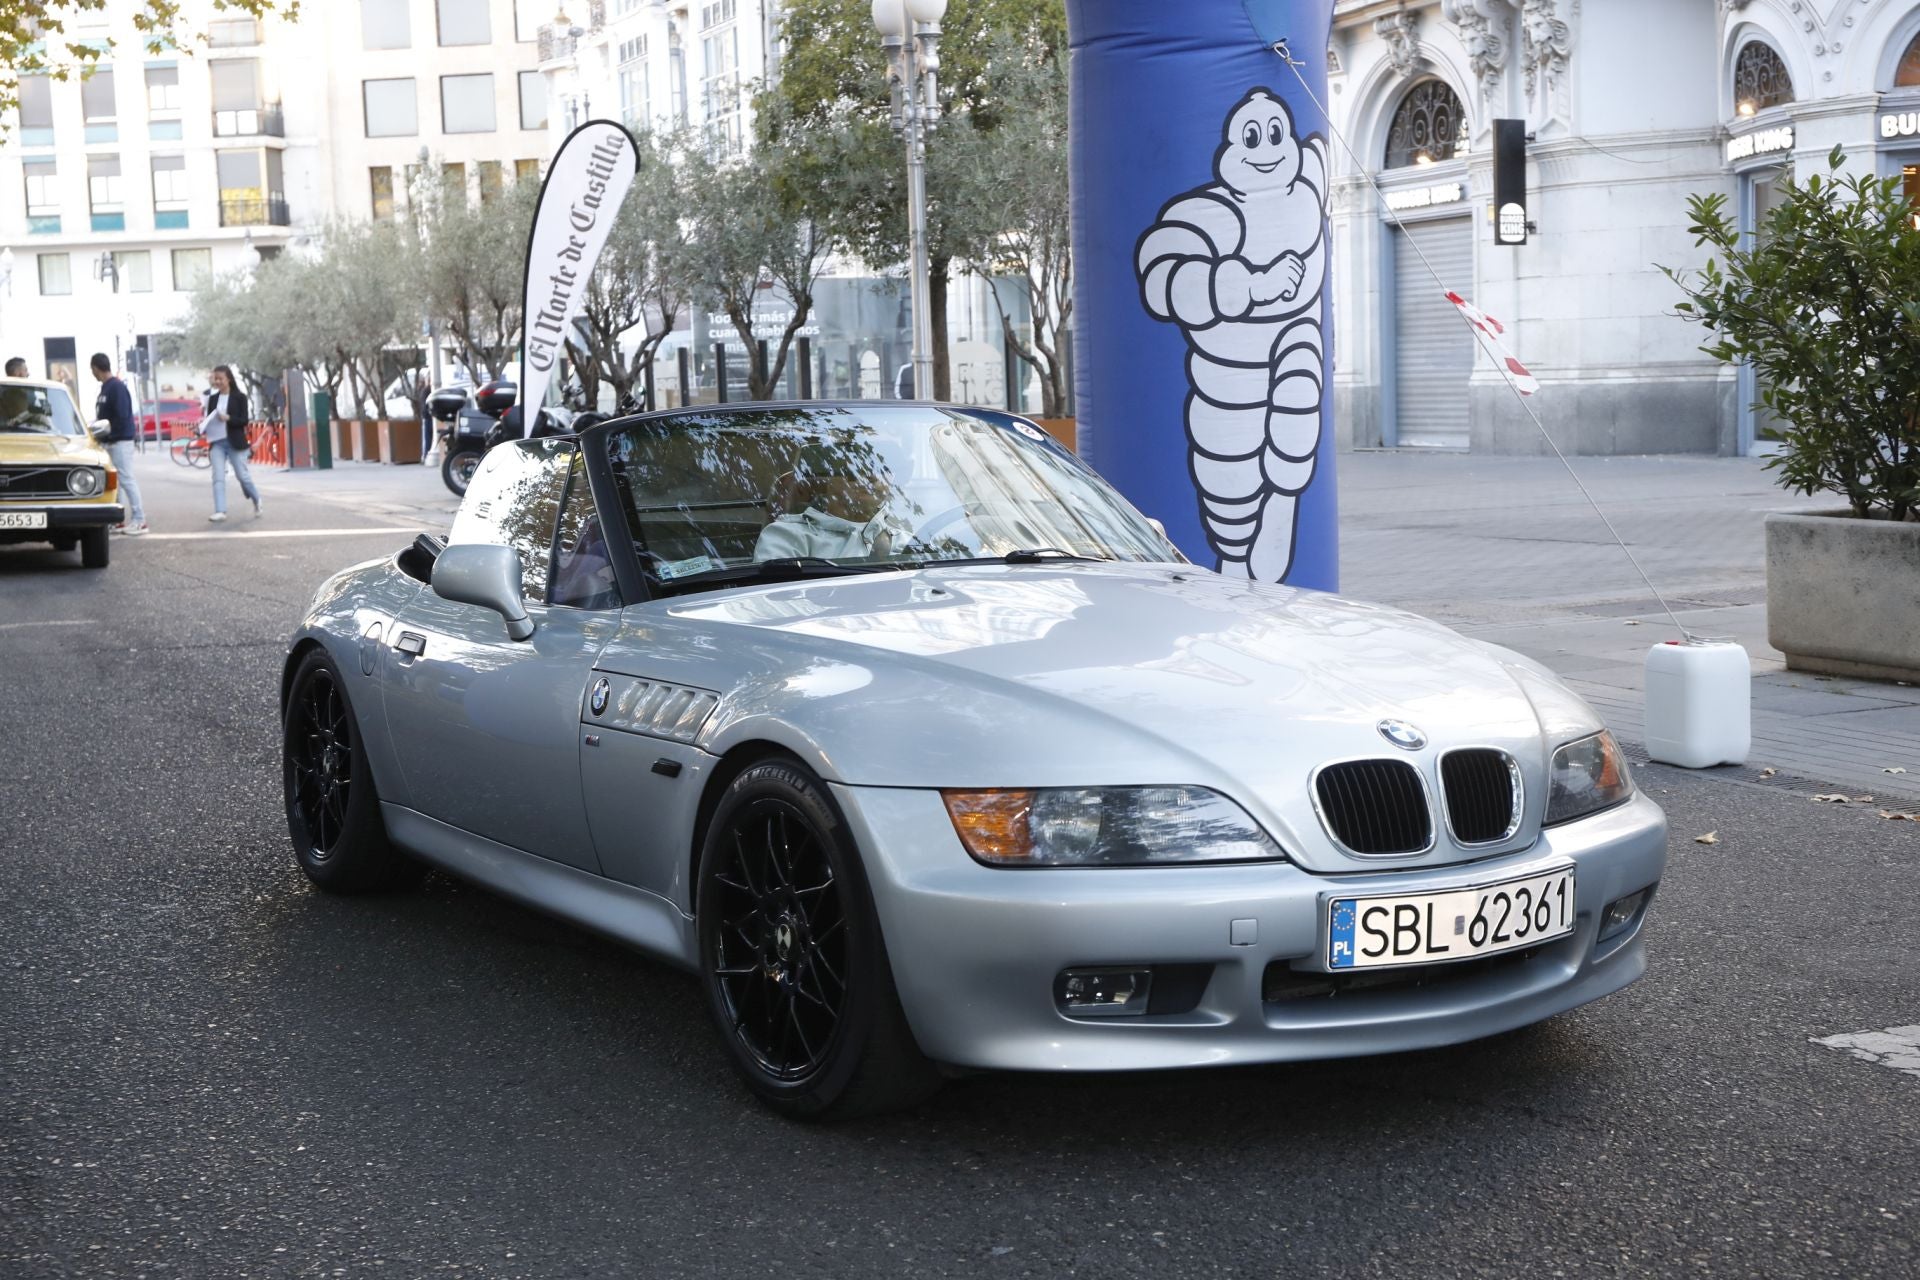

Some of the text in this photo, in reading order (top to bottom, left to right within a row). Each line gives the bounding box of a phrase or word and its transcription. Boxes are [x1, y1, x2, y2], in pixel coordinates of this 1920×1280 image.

[1880, 113, 1920, 138] BU
[1500, 223, 1525, 234] KING
[529, 134, 625, 372] El Norte de Castilla
[759, 310, 786, 322] más
[950, 381, 1004, 404] ING
[37, 514, 45, 526] J
[751, 767, 807, 790] MICHELIN
[1361, 877, 1566, 958] SBL 62361
[1333, 942, 1351, 956] PL
